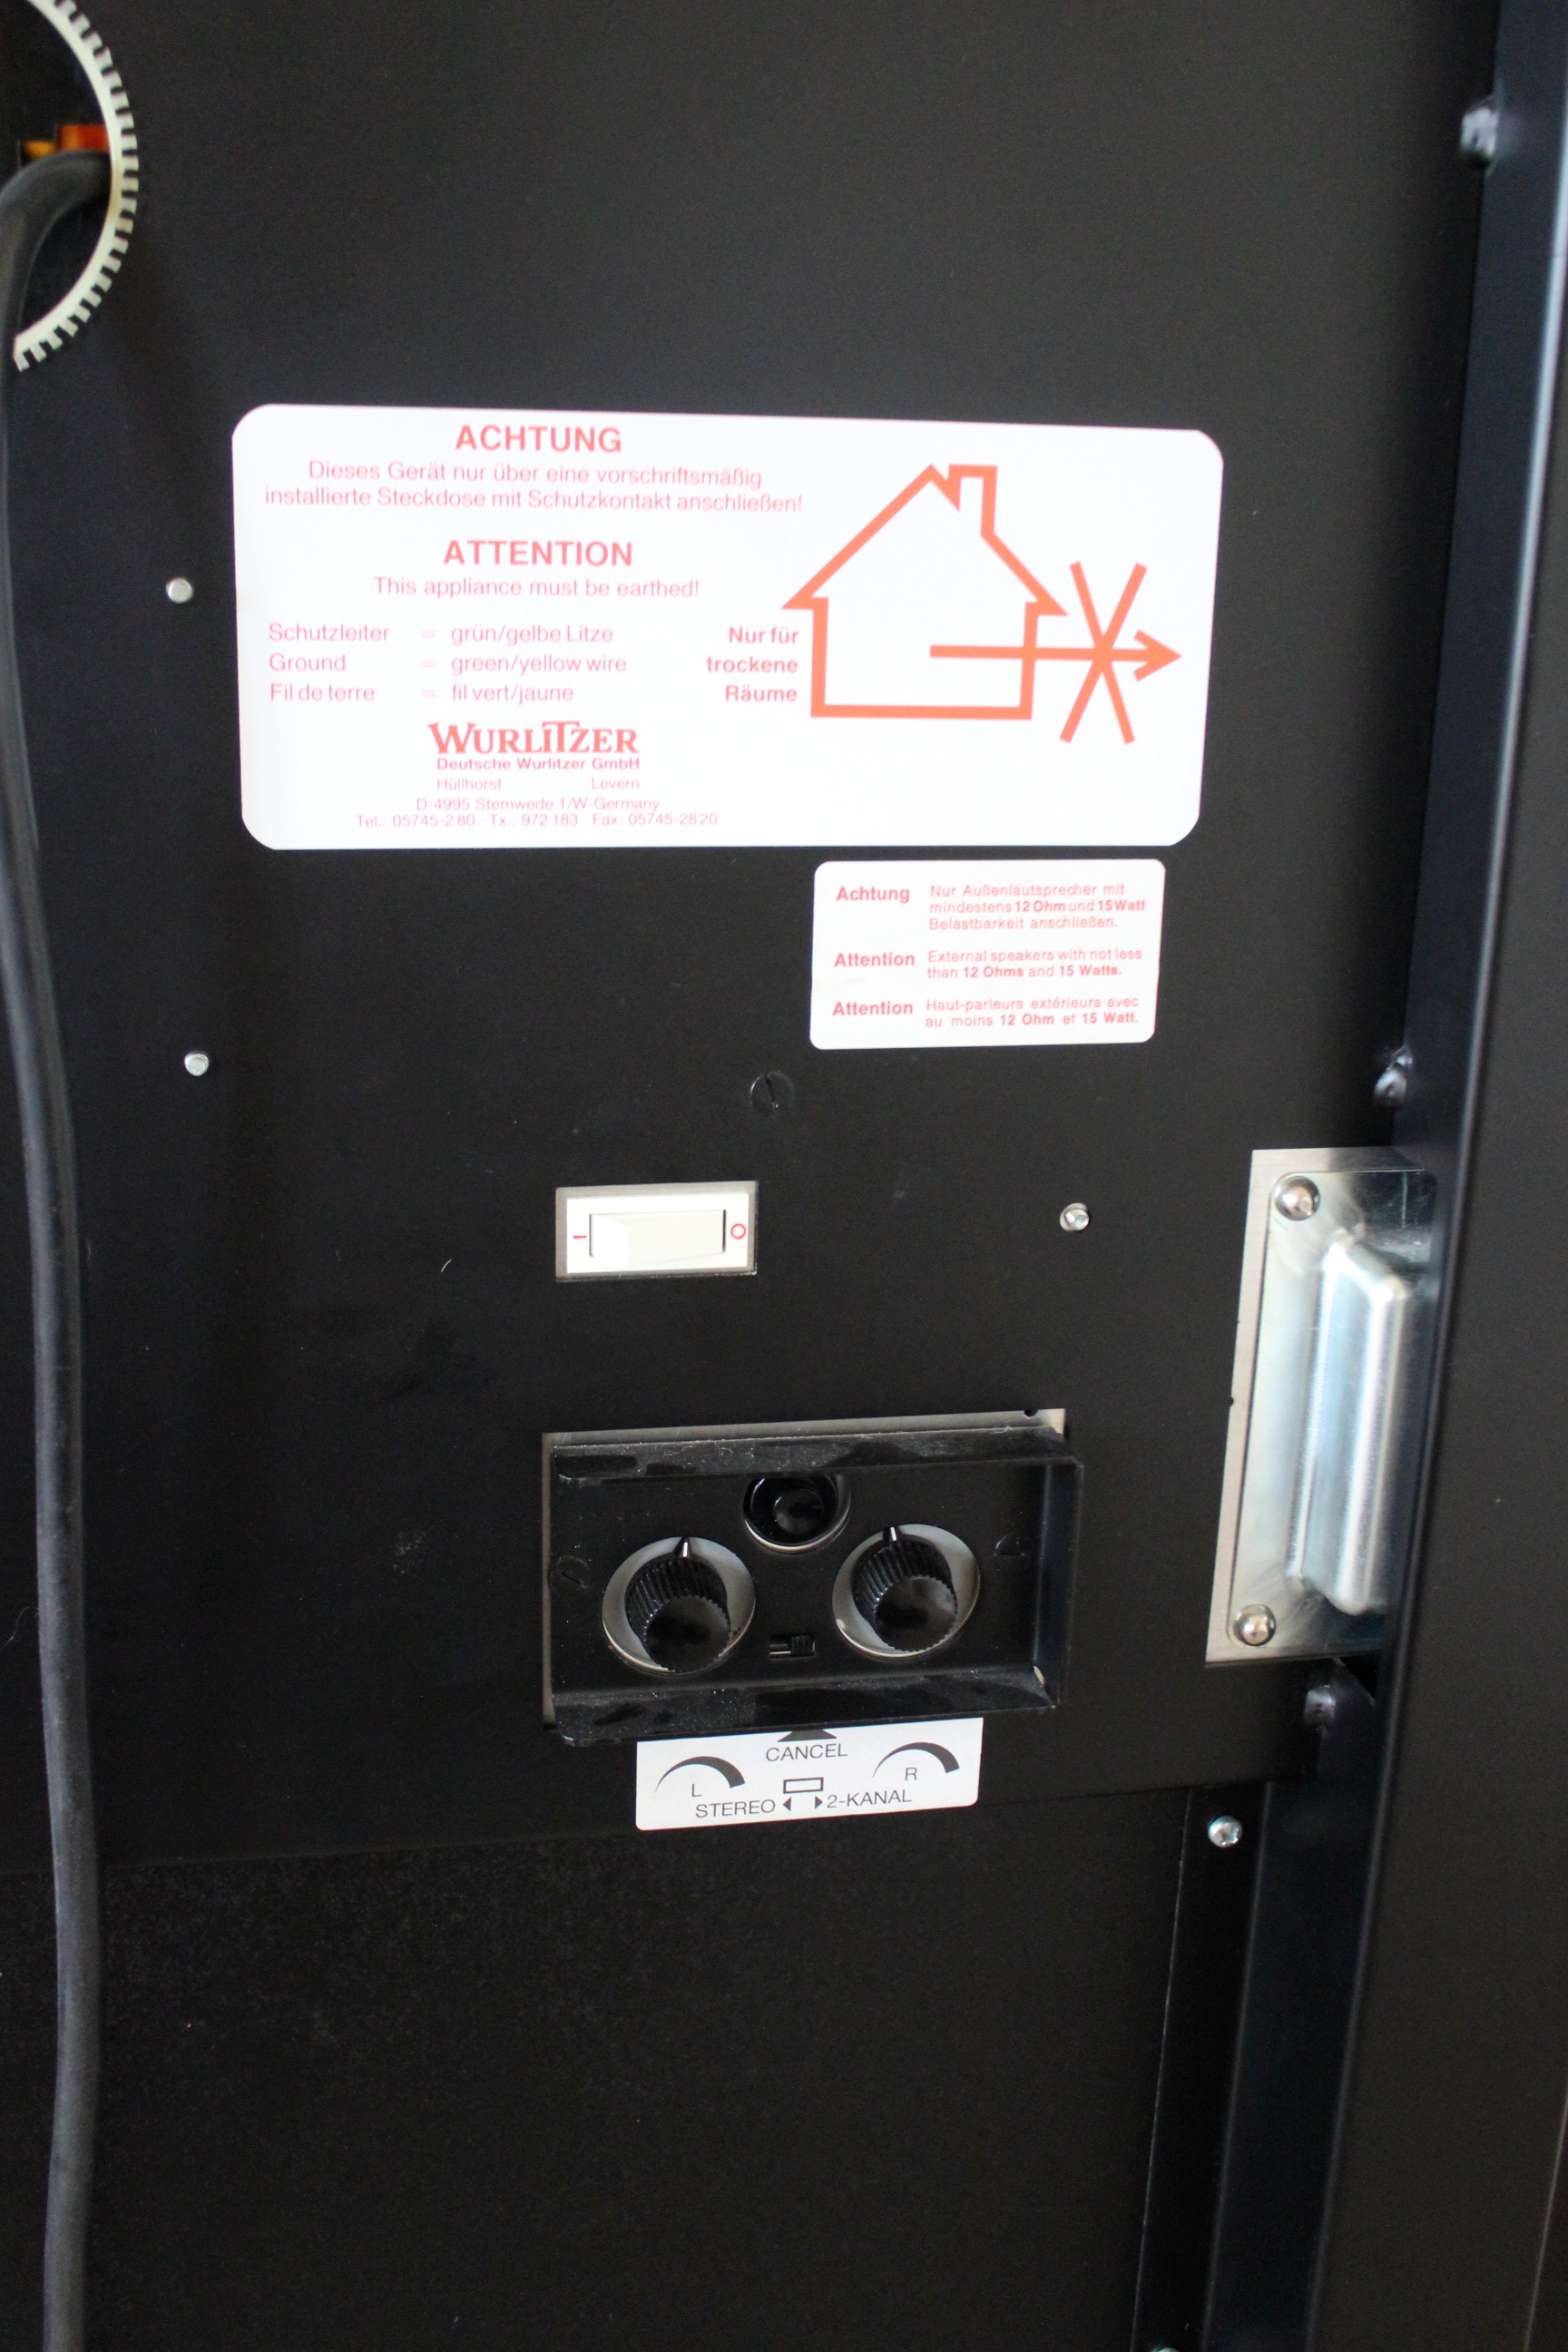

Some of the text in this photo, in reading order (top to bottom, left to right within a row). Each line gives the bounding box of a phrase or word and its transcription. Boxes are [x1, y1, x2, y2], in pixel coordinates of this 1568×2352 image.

[456, 425, 621, 453] ACHTUNG
[309, 460, 761, 491] Dieses Gerät nur über eine vorschriftsmäßig
[266, 486, 801, 512] installierte Steckdose mit Schutzkontakt anschließen!
[444, 540, 632, 566] ATTENTION
[374, 576, 699, 599] This appliance must be earthed!
[270, 622, 389, 641] Schutzleiter
[451, 624, 561, 646] grün/gelbe
[567, 625, 612, 642] Litze
[730, 627, 799, 643] Nur für
[270, 652, 345, 671] Ground
[452, 654, 581, 676] green/yellow
[586, 655, 626, 671] wire
[707, 656, 798, 673] trockene
[270, 683, 292, 701] Fil
[299, 684, 322, 701] de
[328, 685, 375, 701] terre
[452, 683, 466, 701] fil
[472, 684, 573, 705] vert/jaune
[726, 685, 797, 702] Räume
[427, 721, 639, 754] WURLITZER
[437, 758, 640, 769] Deutsche Wurlitzer GmbH
[437, 778, 501, 790] Hüllhorst
[592, 777, 639, 789] Levern
[416, 799, 470, 810] D-4995
[837, 887, 909, 904] Achtung
[931, 884, 1125, 898] Nur Außenlautsprecher mit
[930, 899, 1145, 913] mindestens 12 Ohm und 15 Watt
[929, 916, 1117, 930] Belastbarkeit anschließen.
[834, 952, 915, 967] Attention
[928, 948, 1142, 964] External speakers with not less
[927, 965, 1121, 978] than 12 Ohms and 15 Watts.
[832, 1001, 913, 1016] Attention
[926, 996, 1139, 1013] Haut-parleurs extérieurs avec
[926, 1012, 1138, 1027] au moins 12 Ohm et 15 Watt.
[766, 1743, 848, 1761] CANCEL
[906, 1768, 917, 1780] R
[691, 1784, 701, 1797] L
[828, 1789, 912, 1808] 2-KANAL
[696, 1799, 775, 1818] STEREO
